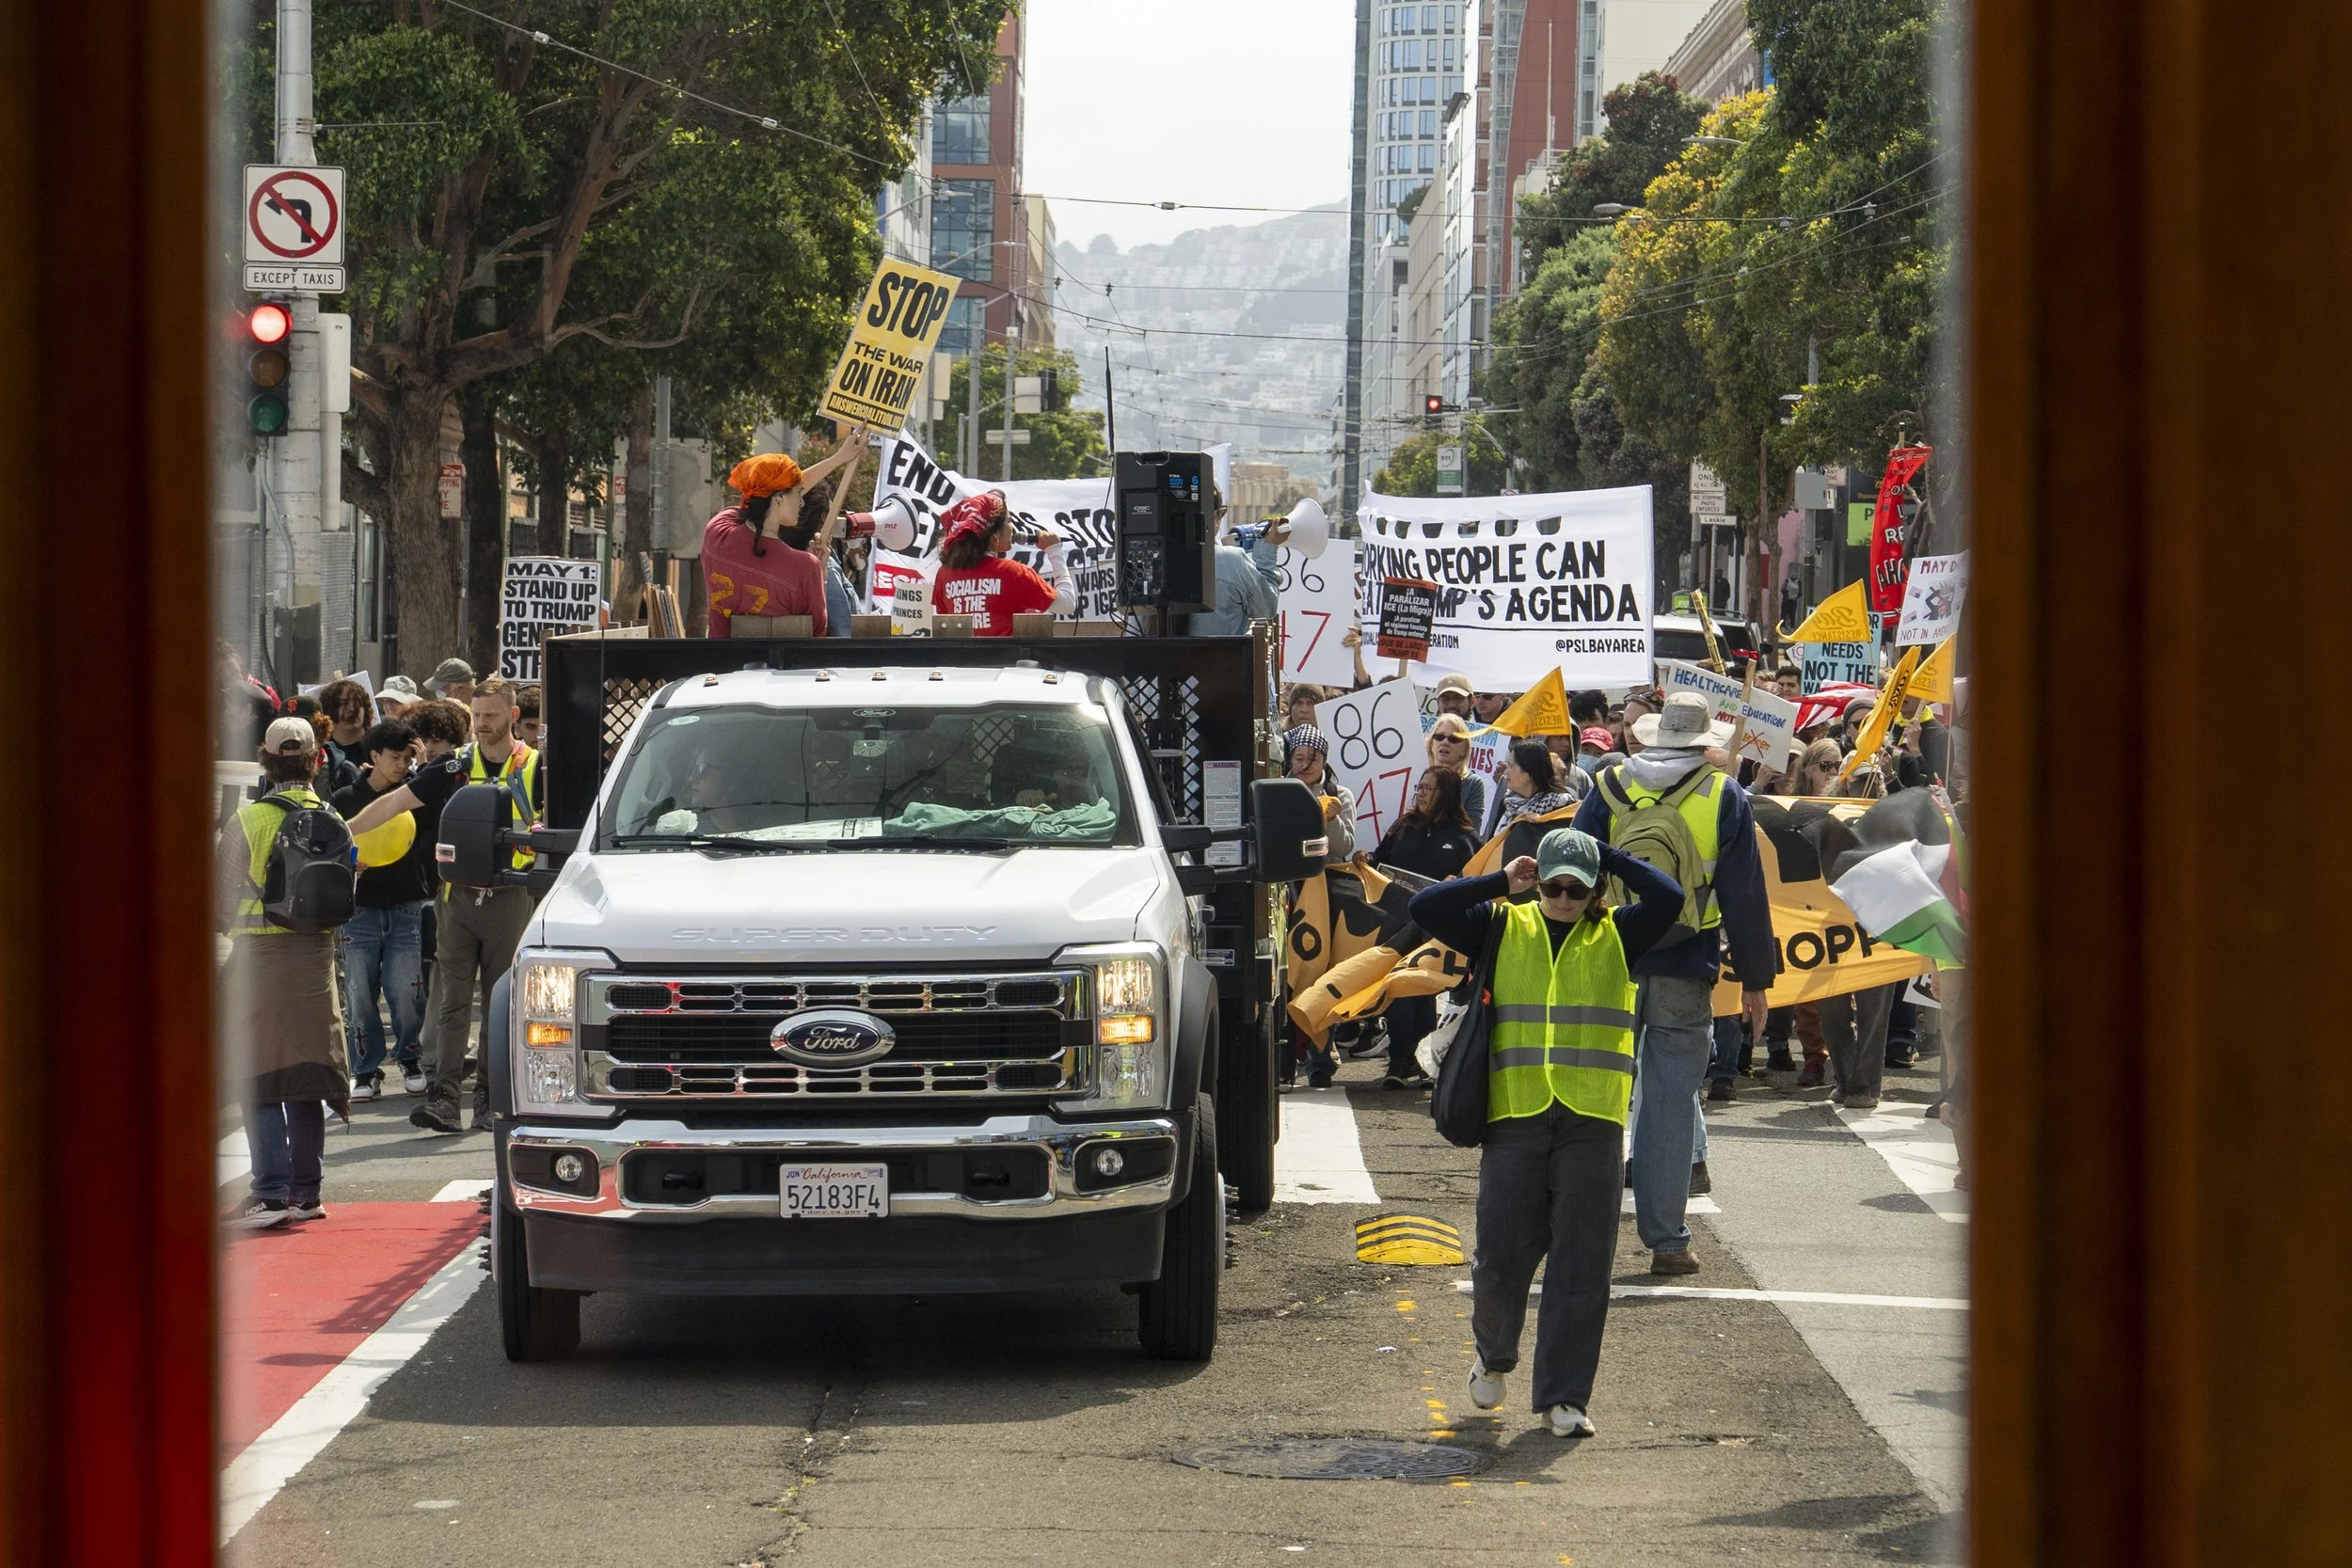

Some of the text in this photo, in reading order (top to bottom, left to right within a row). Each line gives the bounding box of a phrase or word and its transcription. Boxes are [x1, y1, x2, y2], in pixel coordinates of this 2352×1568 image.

[253, 272, 335, 285] EXCEPT TAXIS
[866, 271, 950, 341] STOP
[853, 341, 924, 374] THE WAR
[839, 358, 917, 410] ON IRAN
[886, 439, 956, 506] END
[1055, 508, 1116, 548] STO
[507, 562, 596, 579] MAY 1:
[1362, 539, 1605, 584] ORKING PEOPLE CAN
[1920, 560, 1947, 575] MAY
[504, 578, 597, 602] STAND UP
[946, 578, 1001, 599] SOCIALISM
[1075, 567, 1115, 593] WARS
[710, 572, 769, 617] 27
[953, 595, 986, 614] IS THE
[1094, 590, 1118, 616] ICE
[1390, 594, 1430, 607] PARALIZAR
[1505, 583, 1641, 622] AGENDA
[503, 599, 596, 621] TO TRUMP
[1384, 602, 1396, 611] ICE
[1397, 605, 1408, 614] (La
[1555, 638, 1645, 653] @PSLBAYAREA
[1900, 627, 1918, 641] NOT
[1920, 627, 1929, 640] IN
[1821, 642, 1864, 659] NEEDS
[1674, 667, 1742, 699] HEALTHCARE
[1804, 659, 1876, 685] NOT THE
[1804, 681, 1821, 695] WA
[1714, 710, 1738, 724] NOT
[1333, 691, 1404, 770] 86
[1356, 766, 1412, 841] 47
[671, 925, 997, 942] SUPER DUTY
[804, 1025, 862, 1050] Ford
[786, 1170, 800, 1179] JUN
[803, 1167, 865, 1183] California
[787, 1184, 881, 1210] 52183F4
